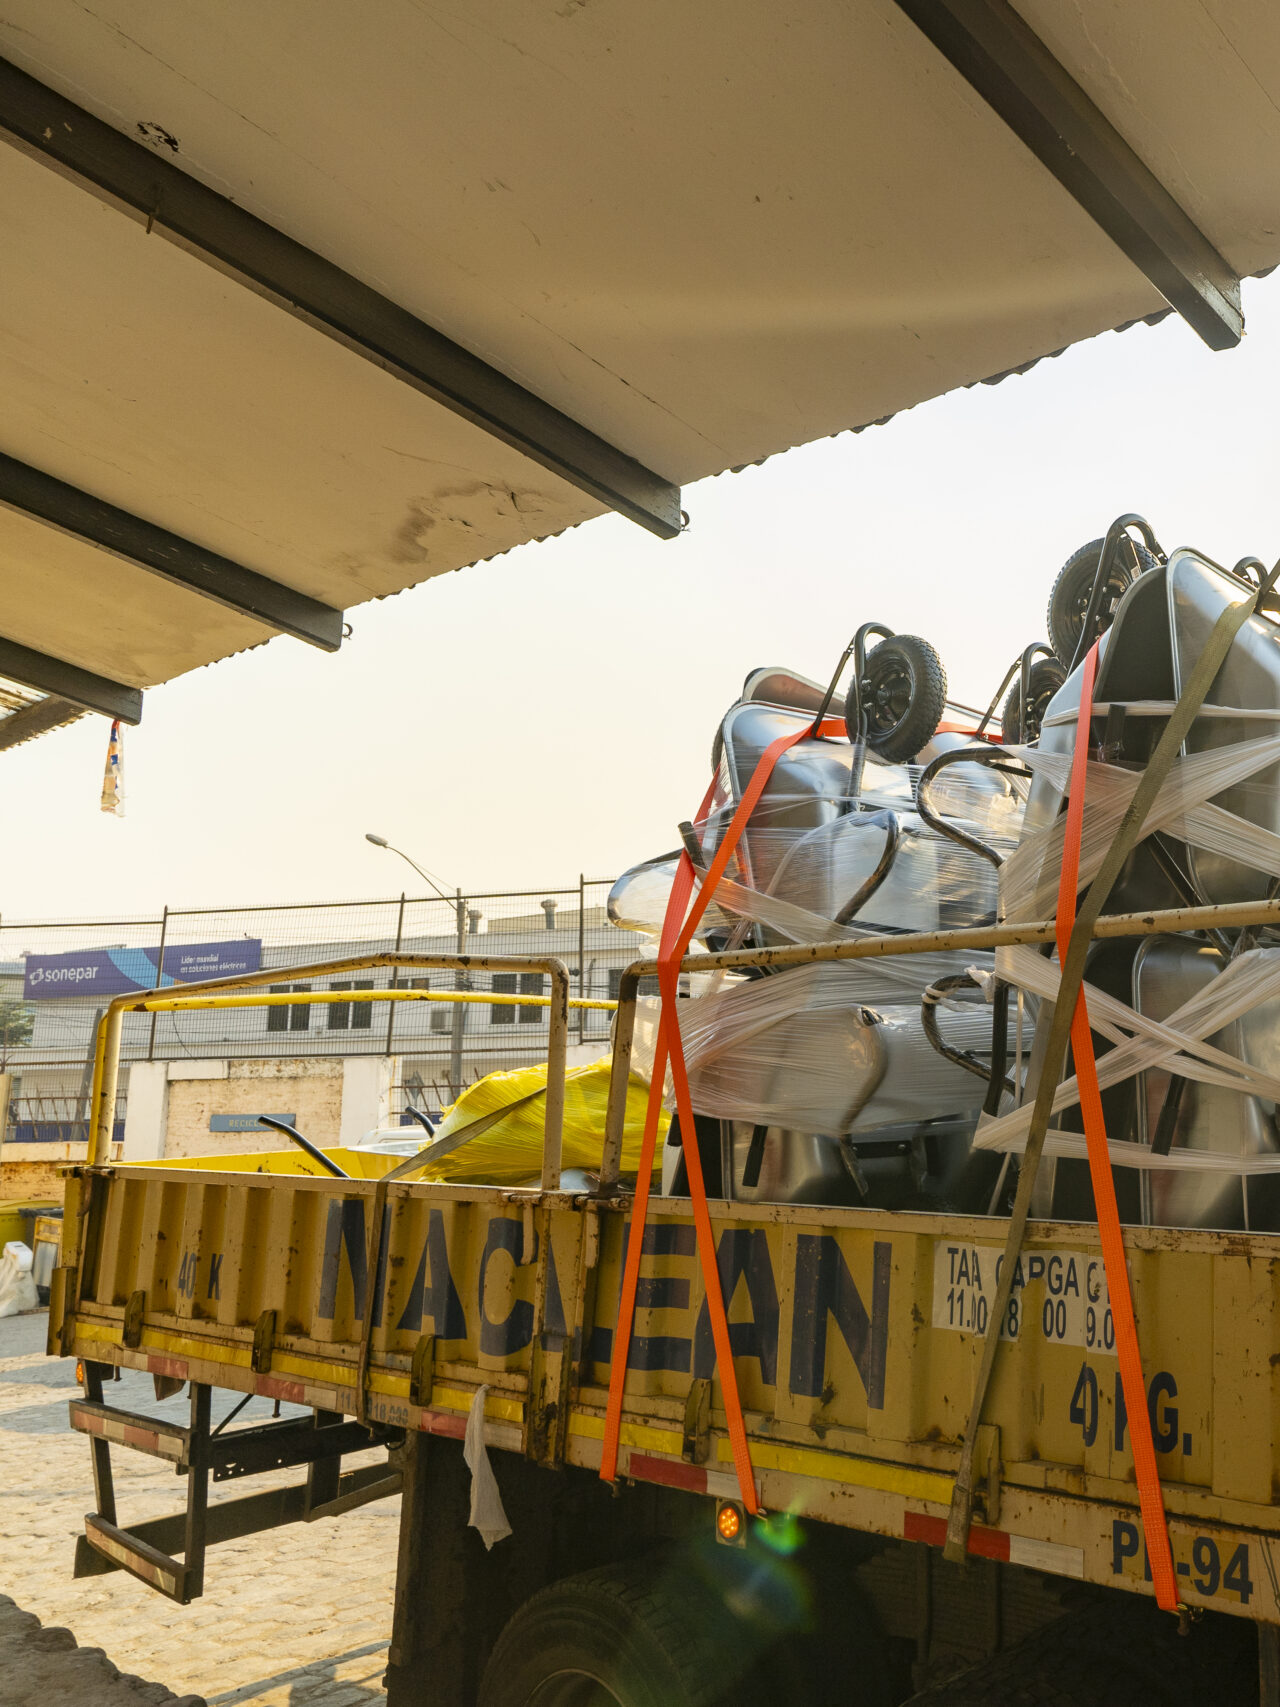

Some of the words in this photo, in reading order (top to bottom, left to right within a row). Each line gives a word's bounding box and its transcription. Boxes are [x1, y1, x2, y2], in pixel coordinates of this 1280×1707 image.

[45, 965, 99, 984] sonepar
[207, 1253, 224, 1300] K
[1086, 1306, 1115, 1350] 9.0
